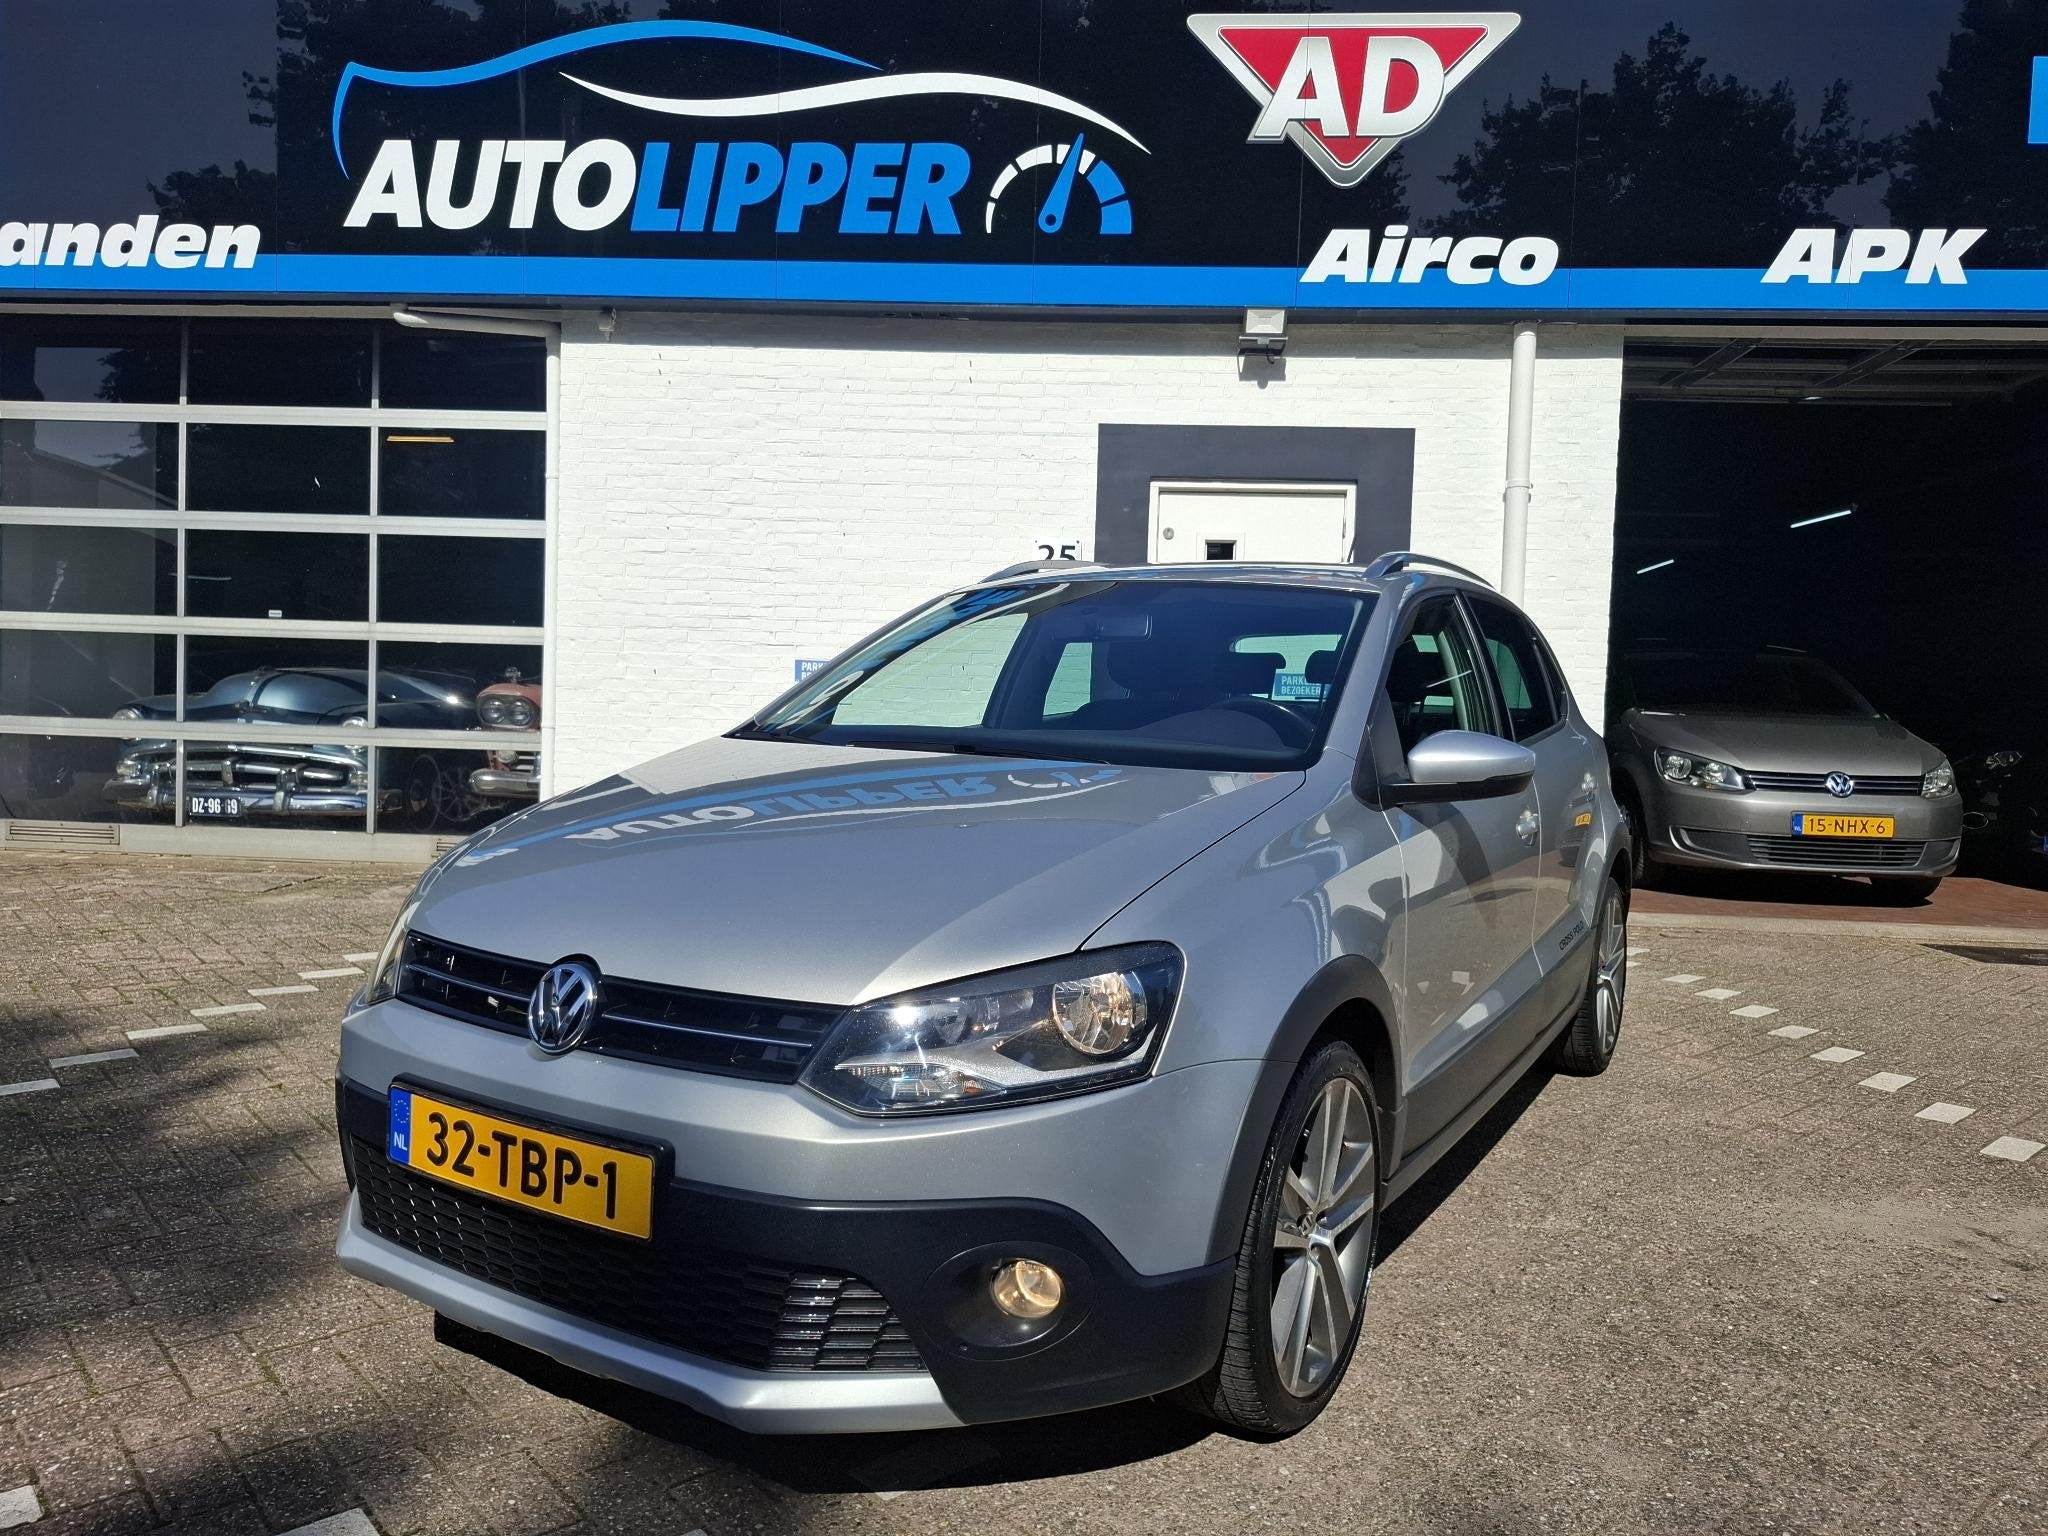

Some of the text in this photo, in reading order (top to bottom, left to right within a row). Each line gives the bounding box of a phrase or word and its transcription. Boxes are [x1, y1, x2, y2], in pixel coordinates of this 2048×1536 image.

[1250, 36, 1445, 140] AD
[0, 215, 261, 269] anden
[1300, 225, 1559, 286] Airco
[1760, 228, 1988, 285] APK
[1038, 544, 1076, 560] 25
[1809, 817, 1886, 835] 15-NHX-6
[393, 1131, 408, 1152] NL
[426, 1111, 619, 1221] 32-TBP-1
